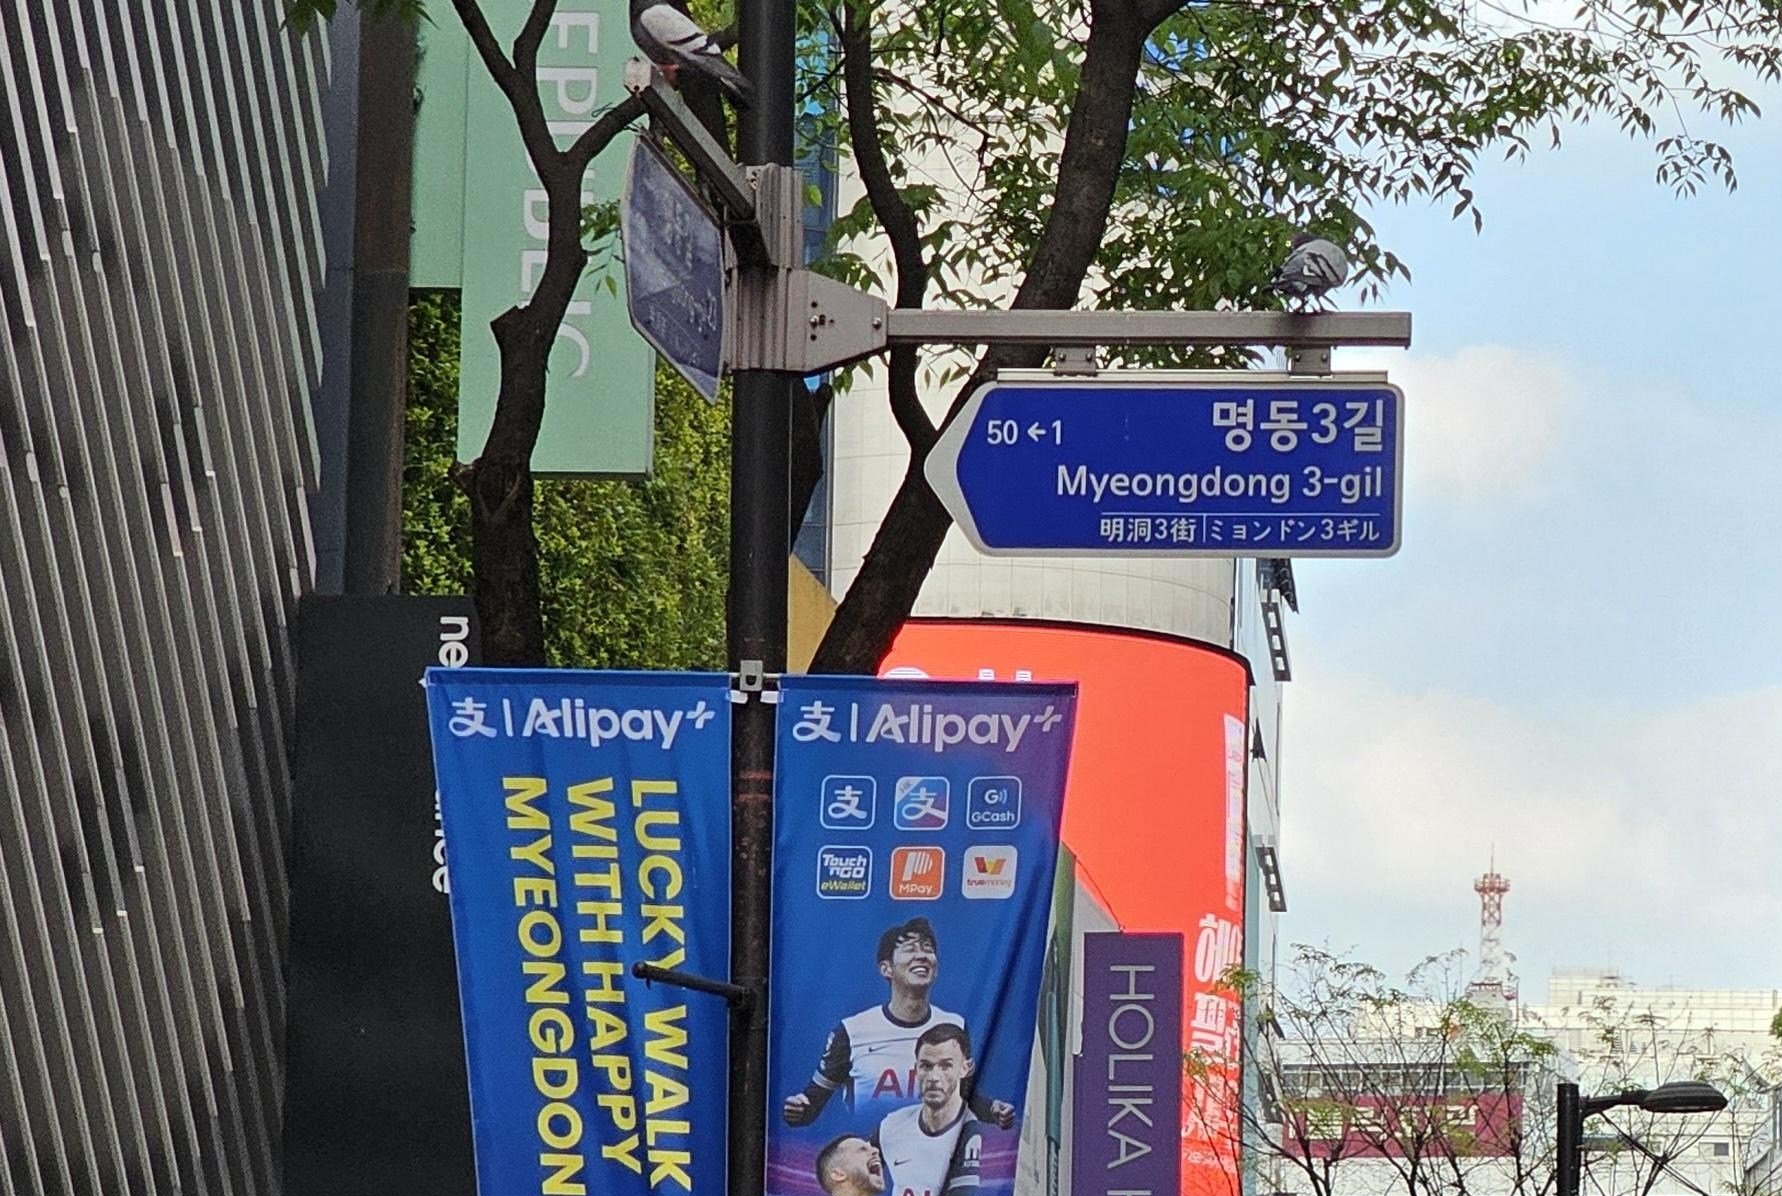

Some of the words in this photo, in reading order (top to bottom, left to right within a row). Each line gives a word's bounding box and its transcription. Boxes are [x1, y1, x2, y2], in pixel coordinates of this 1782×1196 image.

[987, 420, 1018, 445] 50
[1213, 399, 1384, 451] 명동3길
[1057, 465, 1290, 502] Myeongdong
[1302, 466, 1383, 502] 3-gil
[1101, 518, 1195, 542] 明洞3街
[1210, 517, 1380, 541] ミョンドン3ギル
[522, 698, 715, 749] Alipay+
[865, 703, 1063, 752] Alipay+
[971, 811, 1015, 823] GCash
[567, 777, 623, 943] WITH
[631, 780, 686, 970] LUCKY
[822, 854, 867, 868] Touch
[899, 883, 934, 895] MPay
[582, 961, 642, 1175] HAPPY
[1107, 965, 1155, 1169] HOLIKA
[644, 1005, 692, 1192] WALK
